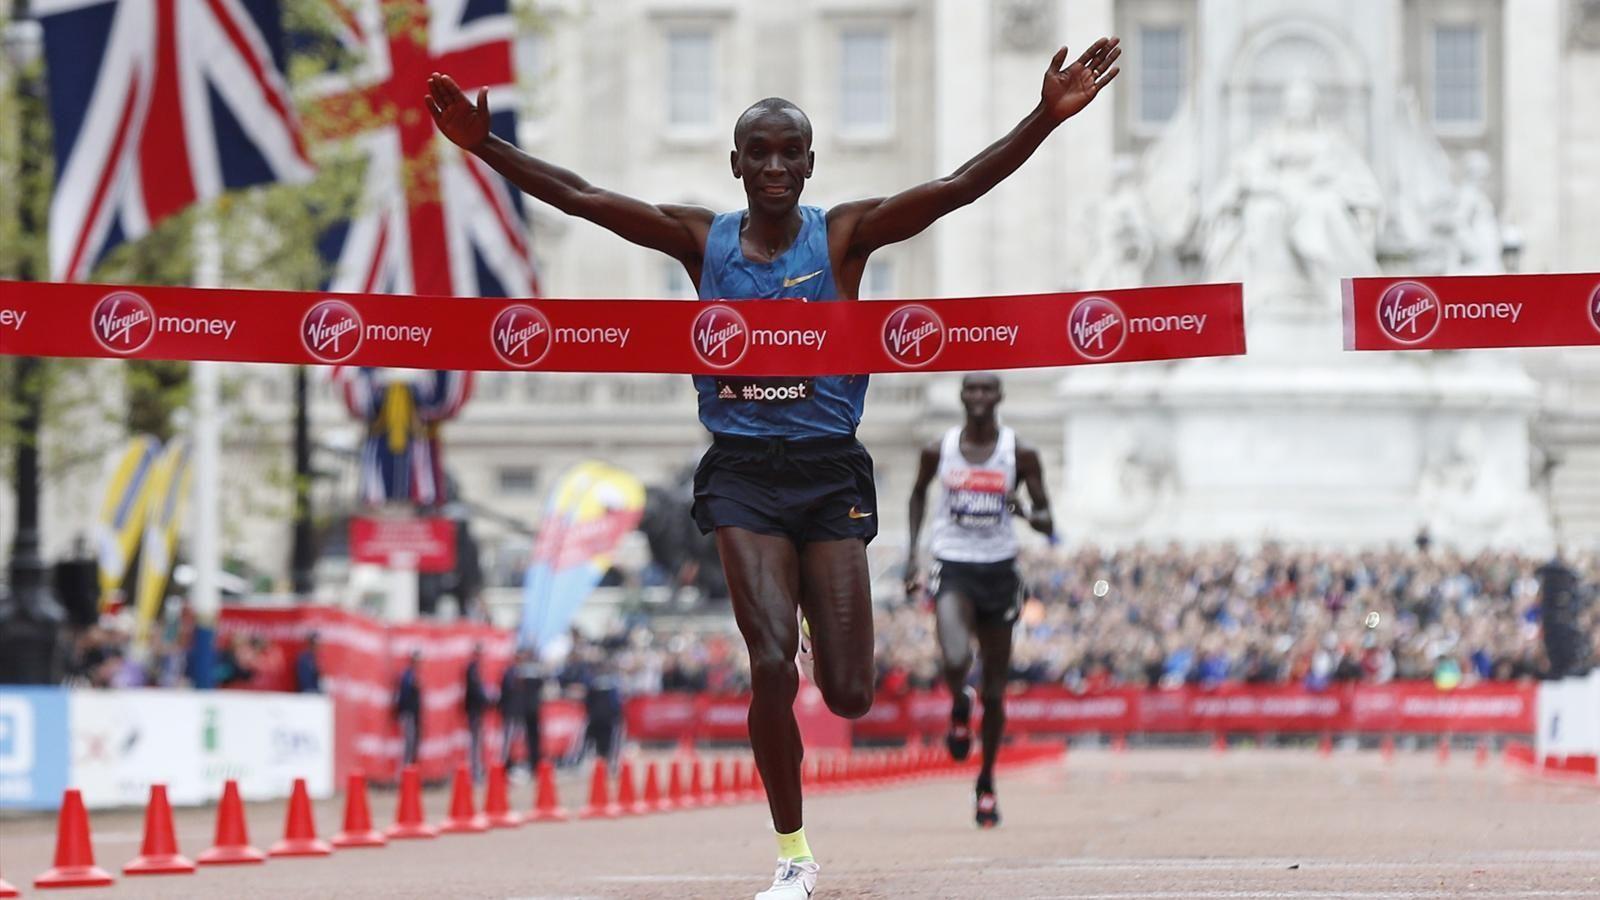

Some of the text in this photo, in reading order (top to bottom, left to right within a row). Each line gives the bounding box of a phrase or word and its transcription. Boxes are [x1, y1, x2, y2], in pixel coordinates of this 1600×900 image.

[99, 300, 236, 343] Virgin money
[307, 309, 432, 352] Virgin money
[1074, 307, 1206, 348] Virgin money
[1385, 290, 1521, 333] Virgin money
[498, 314, 630, 356] Virgin money
[698, 314, 826, 358] Virgin money
[889, 313, 1018, 356] Virgin money
[742, 383, 806, 400] #boost
